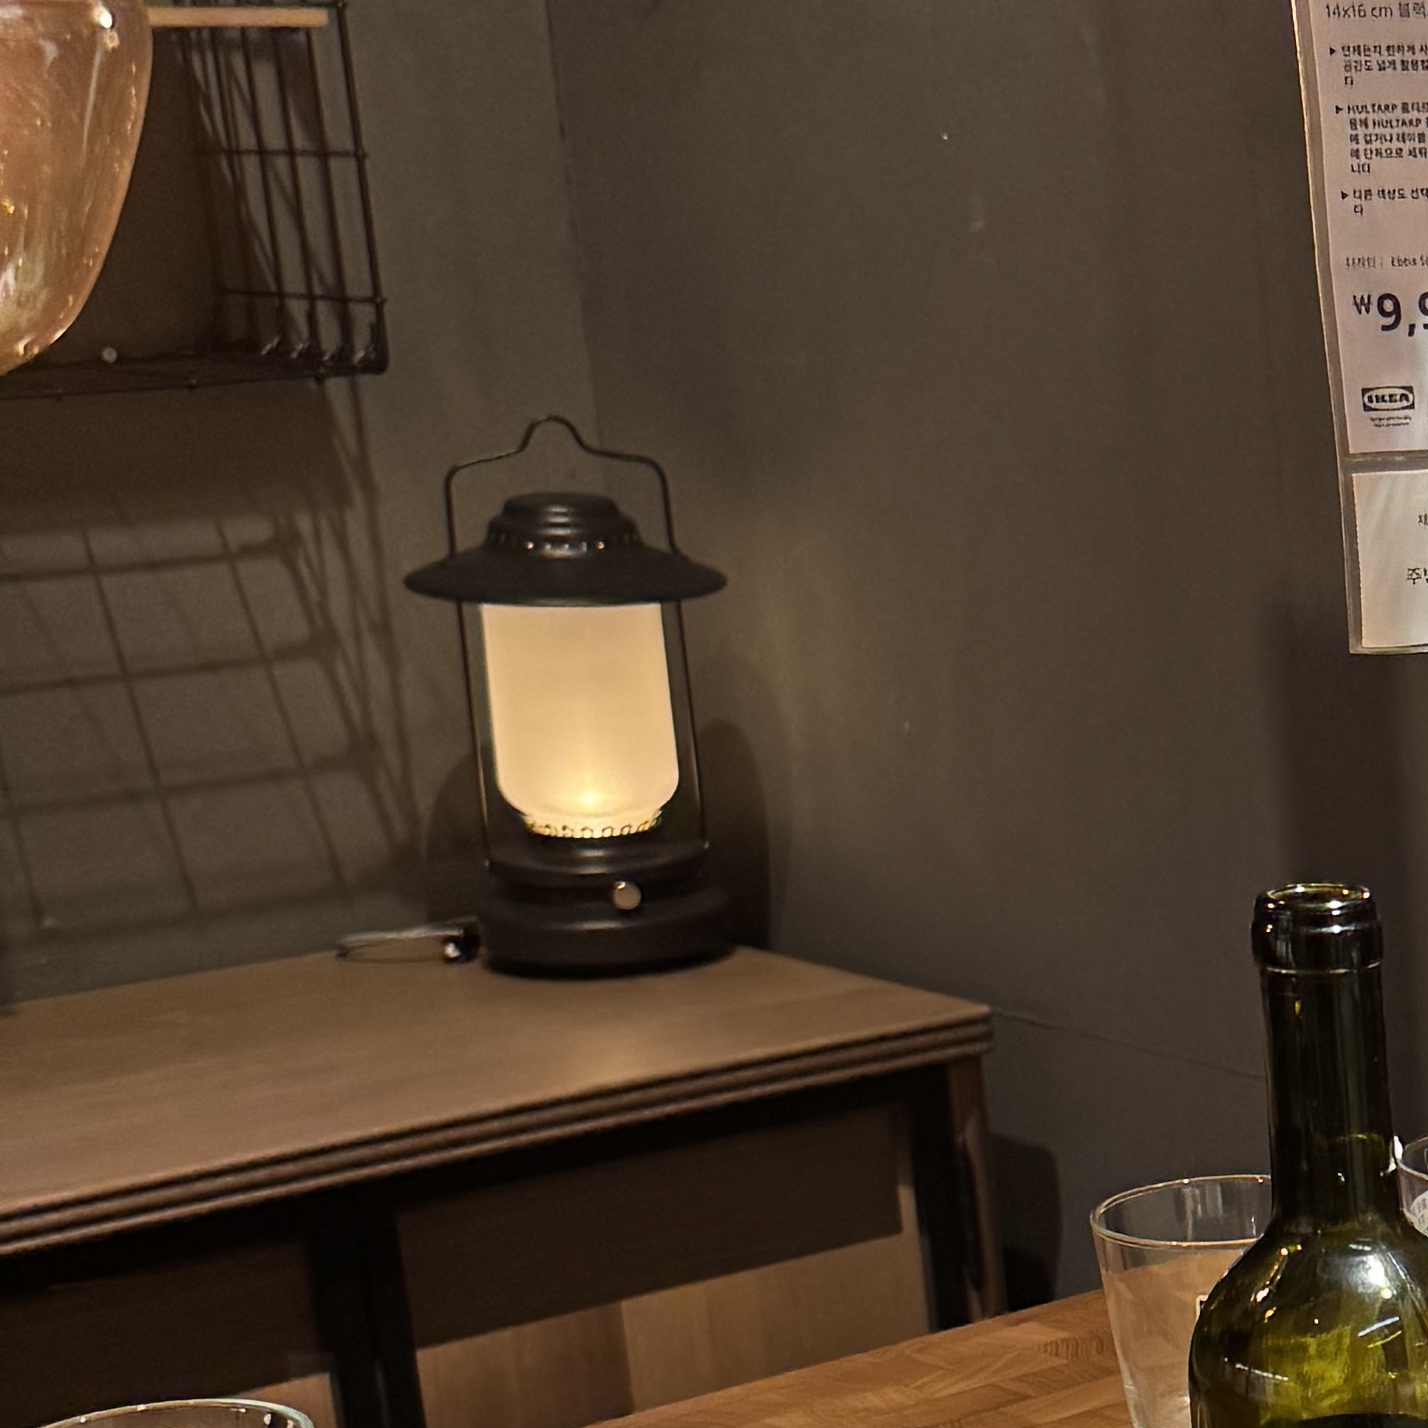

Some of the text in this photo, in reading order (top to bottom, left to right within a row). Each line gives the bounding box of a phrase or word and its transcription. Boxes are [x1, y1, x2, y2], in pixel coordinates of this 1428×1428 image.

[1326, 3, 1366, 18] 14x16
[1371, 6, 1392, 18] cm
[1348, 104, 1397, 115] HULTARP
[1372, 118, 1422, 129] HULTARP
[1351, 163, 1371, 174] 니다
